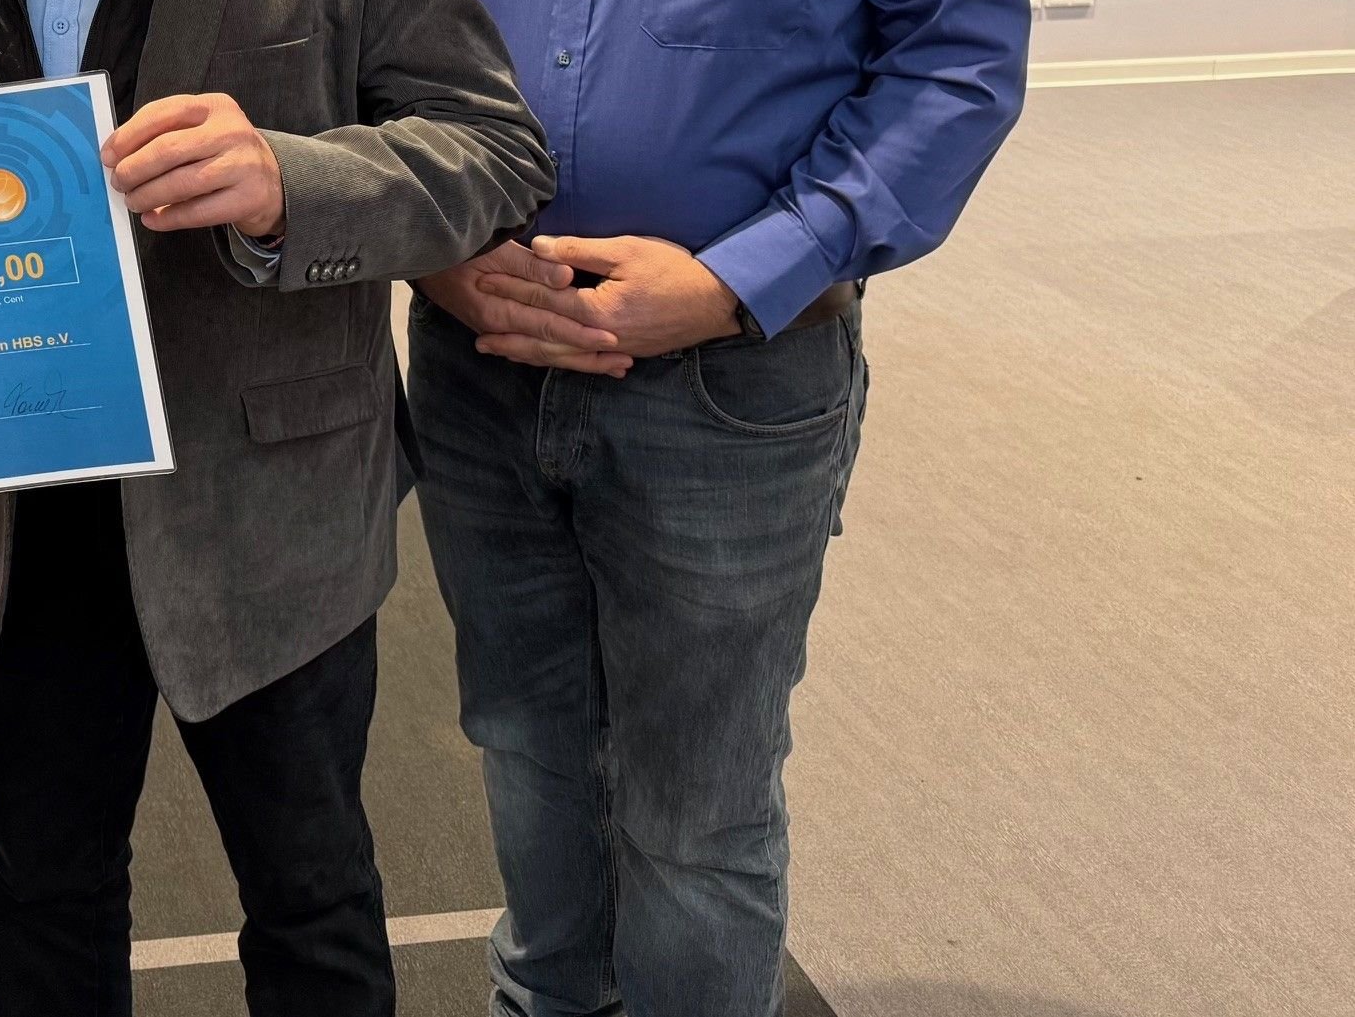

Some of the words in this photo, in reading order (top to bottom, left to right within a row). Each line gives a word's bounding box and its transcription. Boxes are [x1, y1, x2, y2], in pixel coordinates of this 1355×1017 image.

[3, 294, 24, 304] Cent
[12, 335, 43, 350] HBS
[46, 332, 74, 346] e.V.
